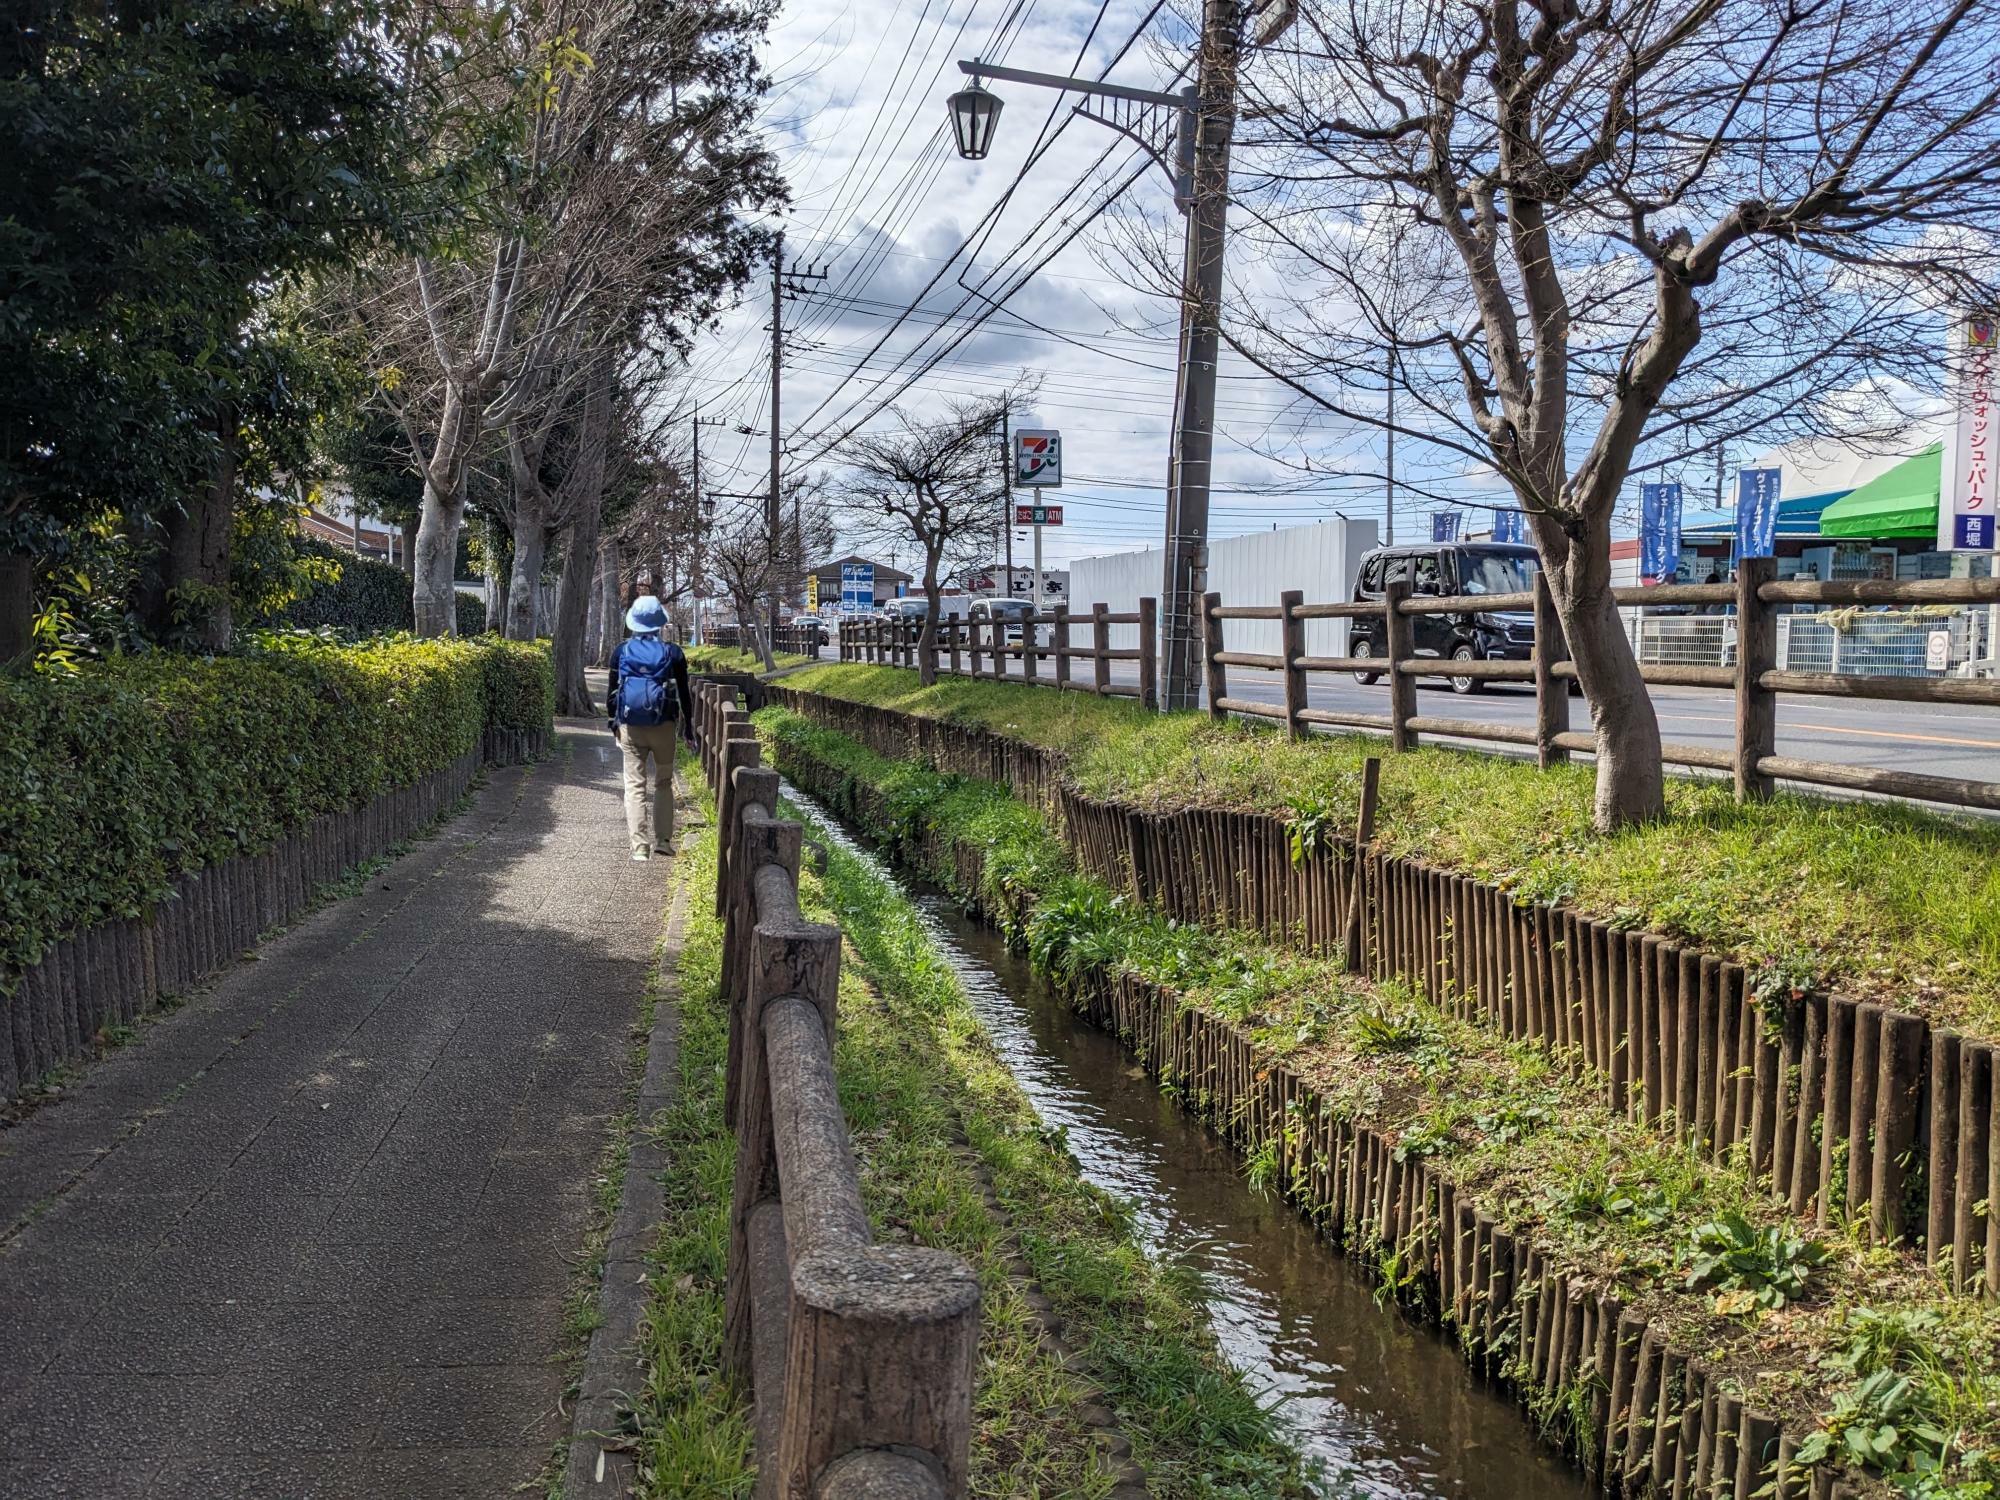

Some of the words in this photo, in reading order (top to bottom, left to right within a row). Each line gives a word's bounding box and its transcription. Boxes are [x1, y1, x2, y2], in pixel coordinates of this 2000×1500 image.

[1017, 510, 1032, 520] たばこ
[1034, 510, 1045, 521] 酒
[1047, 510, 1062, 521] ATM
[1656, 487, 1668, 584] ヴェールコーティング
[1965, 517, 1982, 547] 西堀
